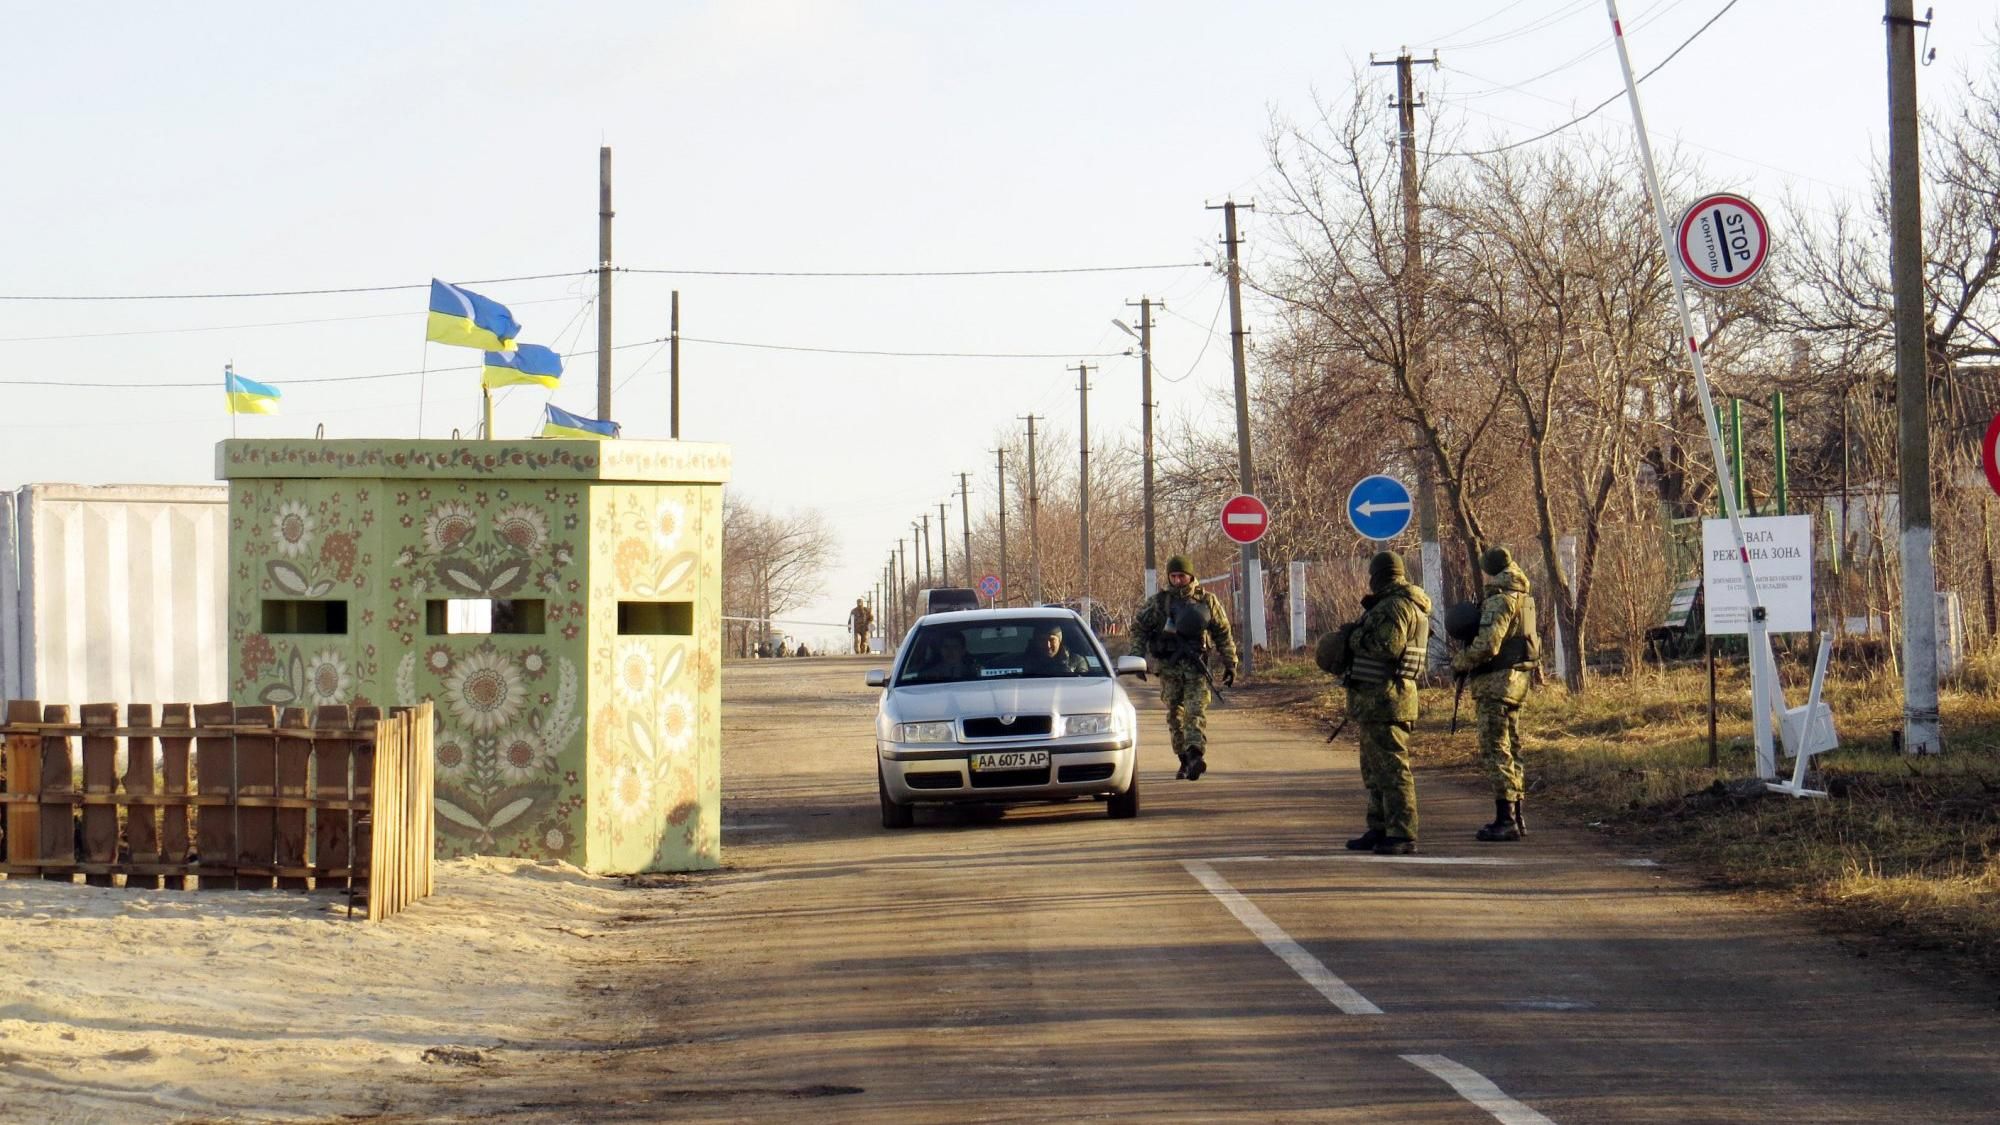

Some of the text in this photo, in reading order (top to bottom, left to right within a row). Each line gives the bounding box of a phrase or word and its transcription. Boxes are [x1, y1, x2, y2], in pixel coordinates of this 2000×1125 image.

[1700, 216, 1719, 273] КОНТРОЛЬ
[1726, 214, 1751, 261] STOP
[1743, 530, 1774, 543] ВАГА
[1771, 547, 1801, 559] ЗОНА
[979, 752, 1046, 768] AA 6075 AP
